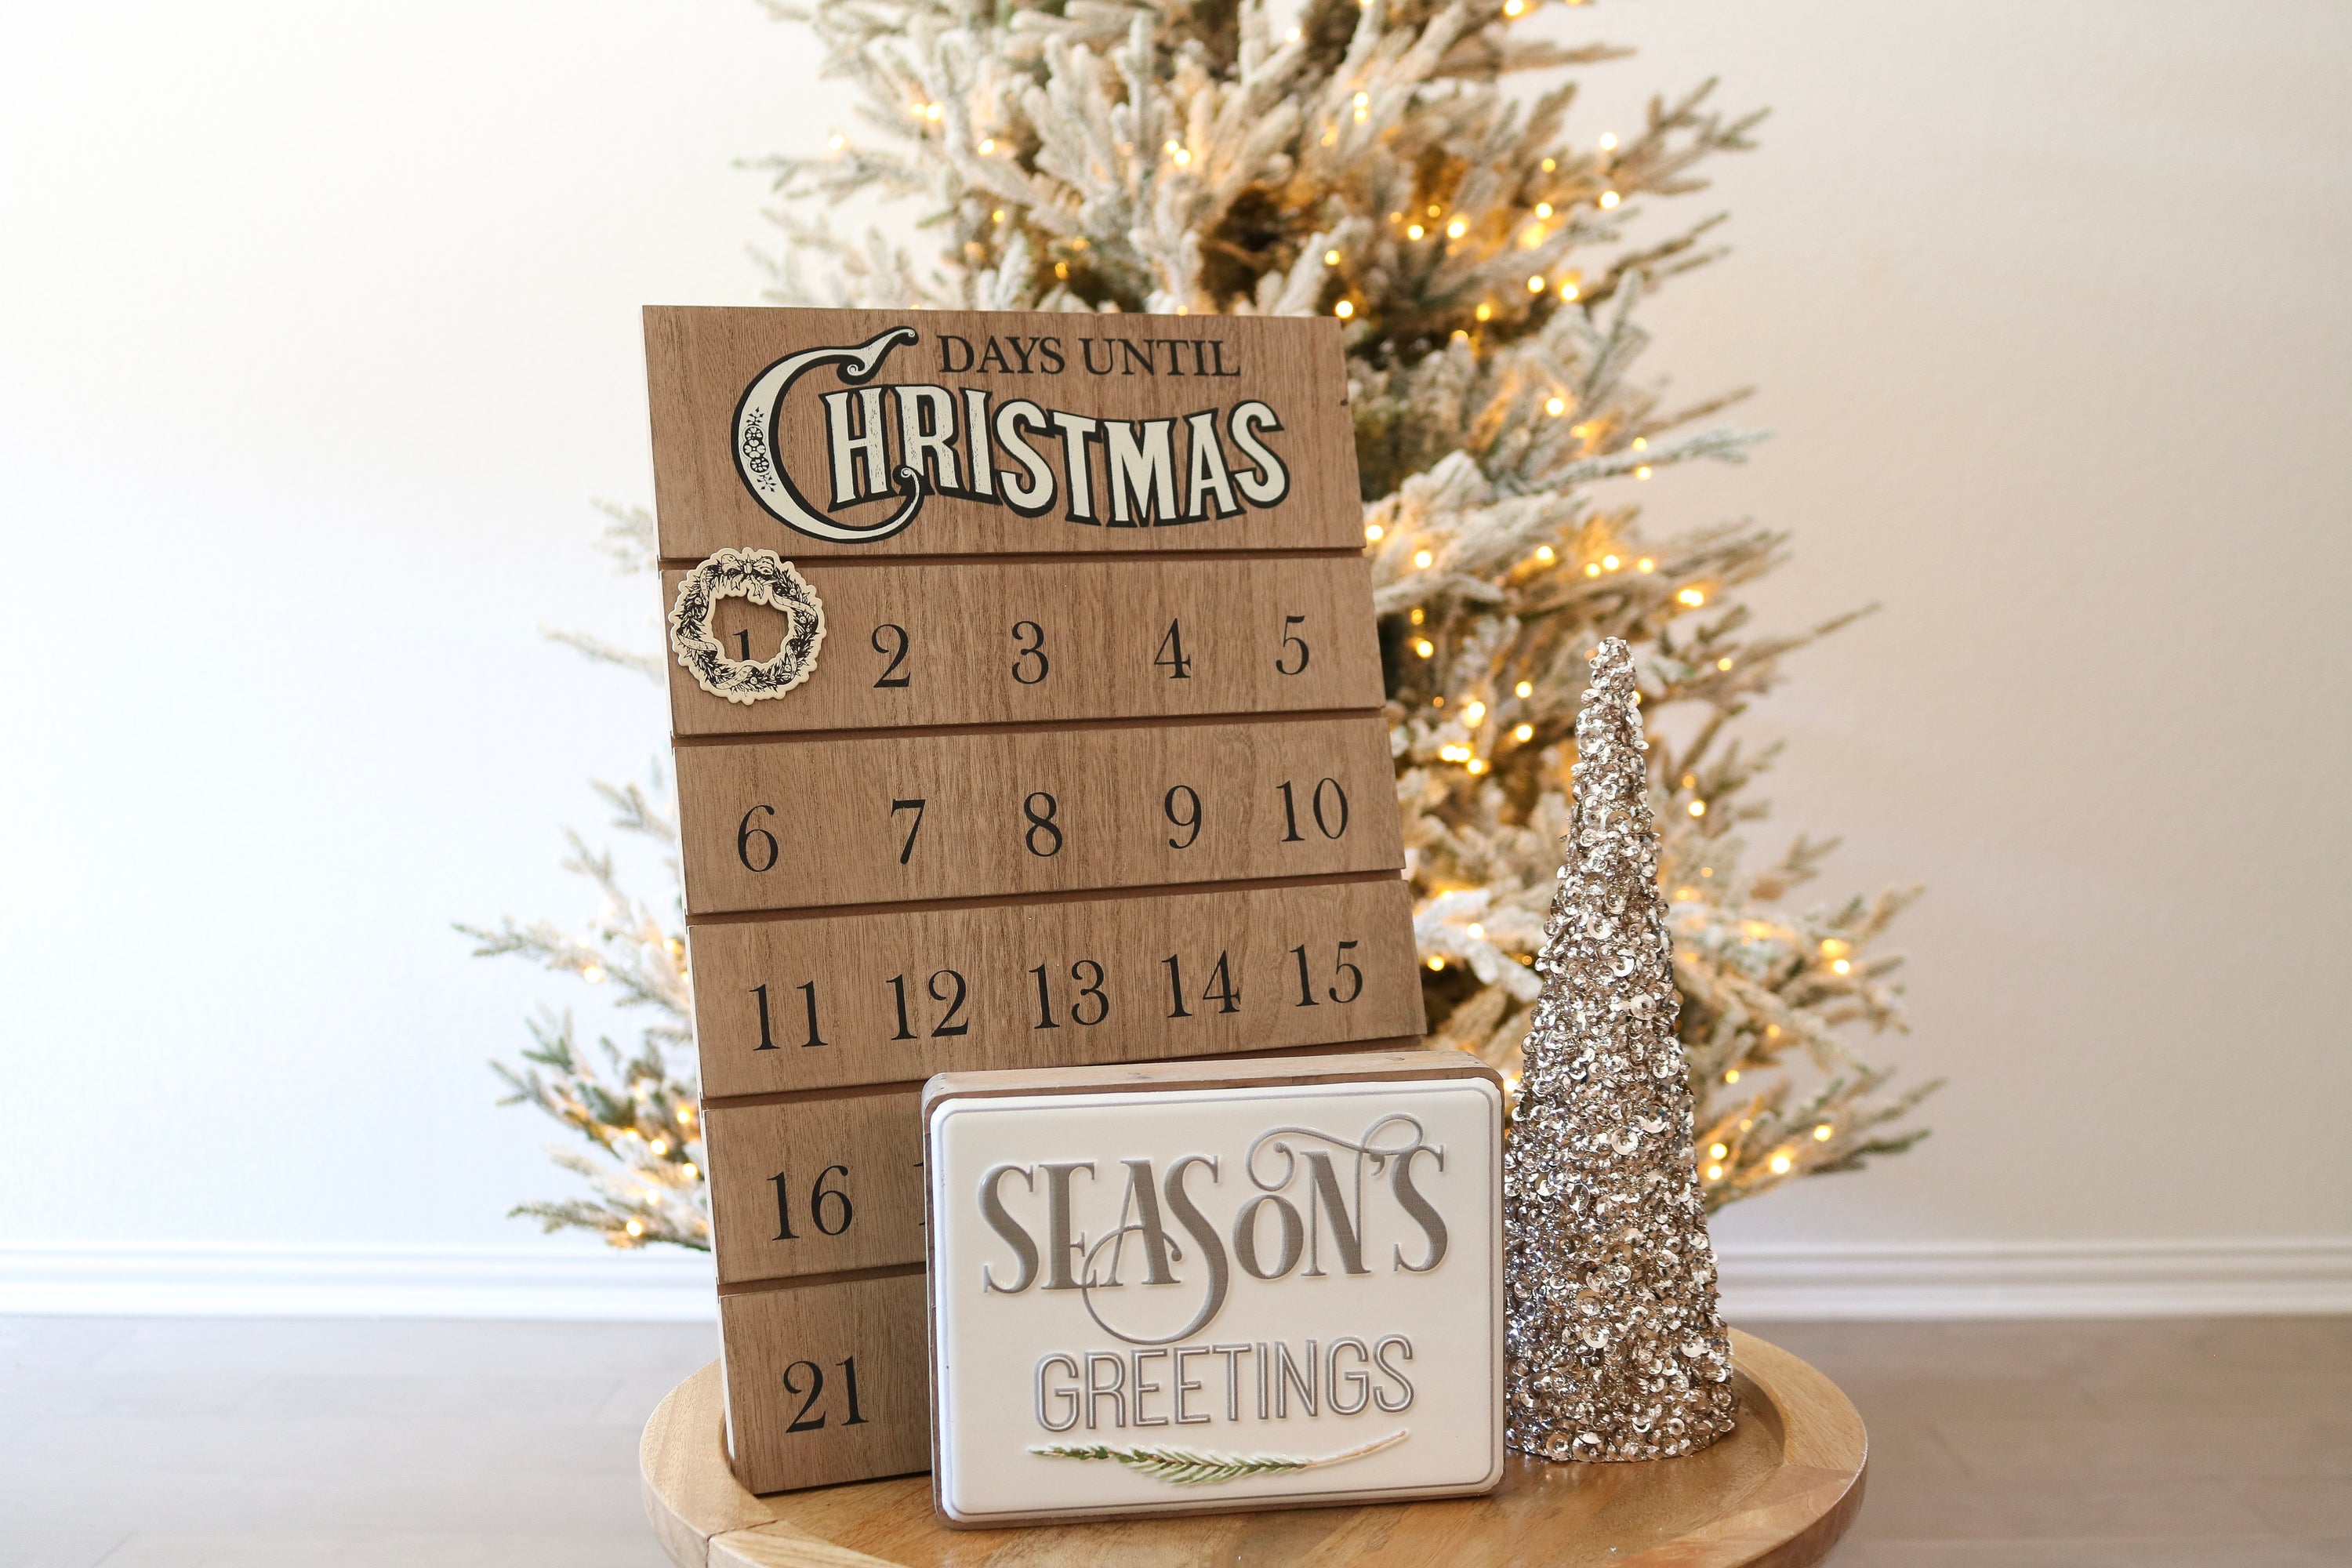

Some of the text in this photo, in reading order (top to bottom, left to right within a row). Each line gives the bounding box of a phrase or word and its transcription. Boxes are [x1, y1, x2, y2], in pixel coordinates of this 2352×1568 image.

[938, 336, 1241, 377] DAYS UNTIL
[730, 325, 1290, 545] CHRISTMAS
[871, 623, 910, 688] 2
[1011, 620, 1049, 684] 3
[1153, 618, 1192, 679] 4
[1276, 615, 1309, 676] 5
[737, 777, 1348, 872] 6 7 8 9 10
[750, 940, 1363, 1051] 11 12 13 14 15
[766, 1164, 853, 1242] 16
[978, 1113, 1449, 1345] SEASON'S
[782, 1355, 869, 1434] 21
[1034, 1333, 1415, 1432] GREETINGS
